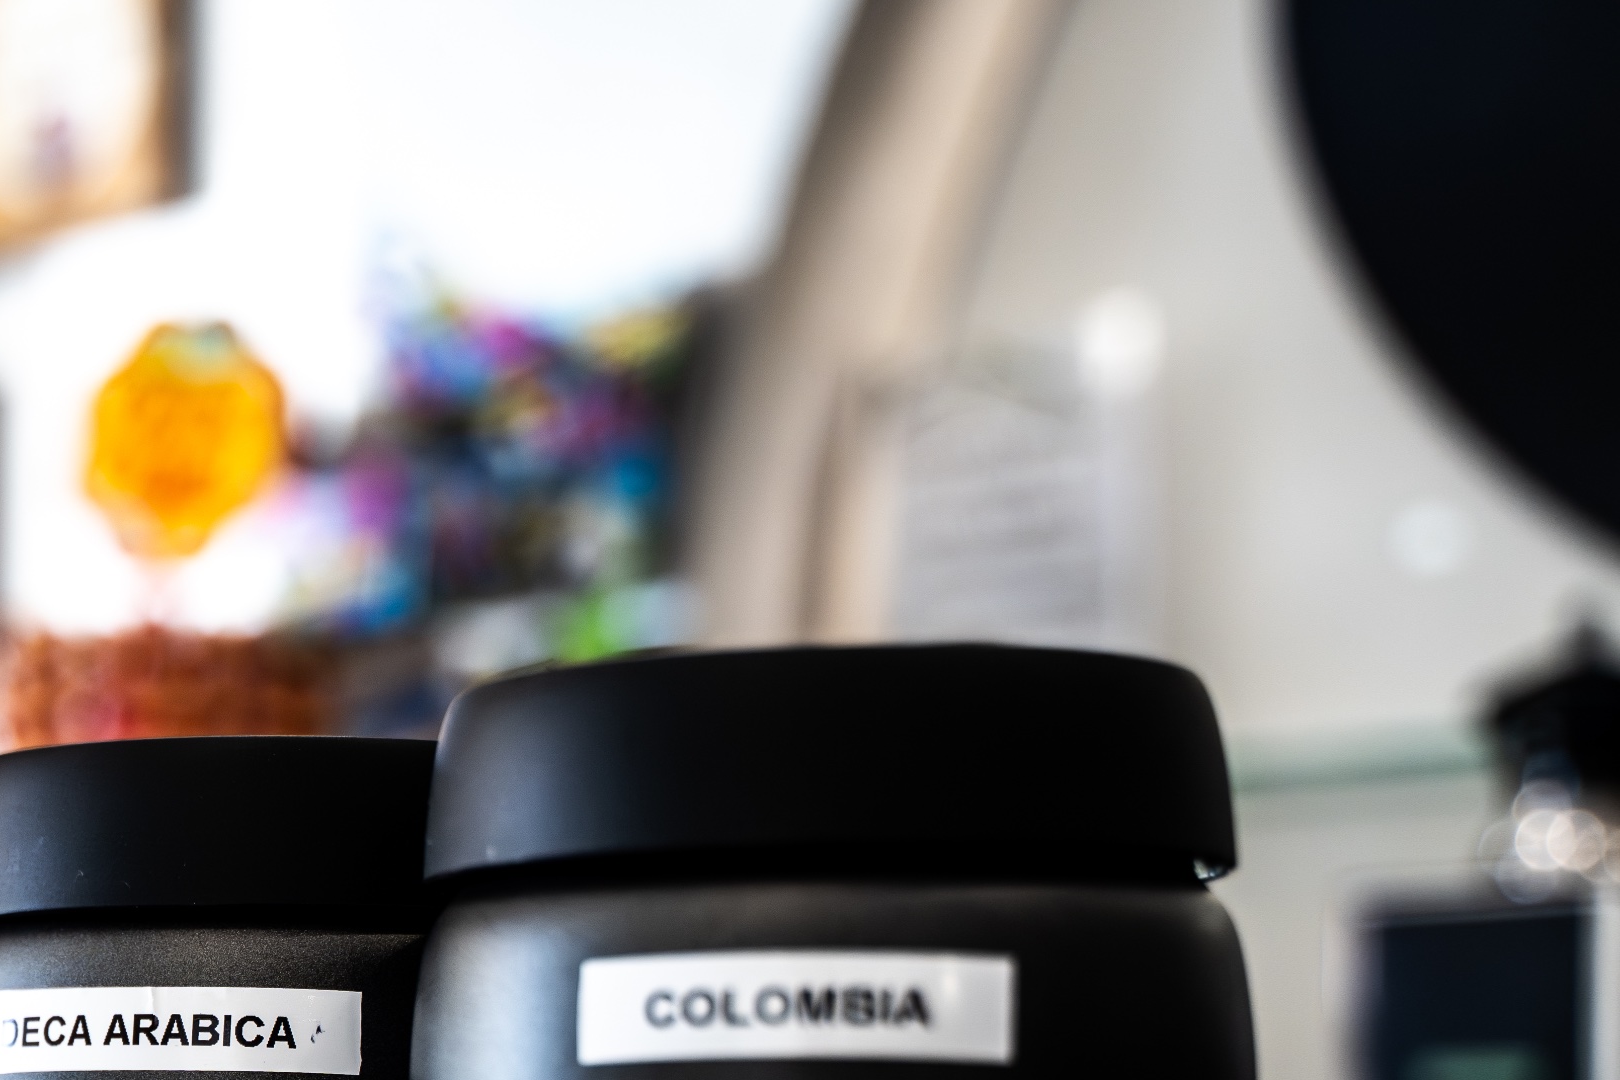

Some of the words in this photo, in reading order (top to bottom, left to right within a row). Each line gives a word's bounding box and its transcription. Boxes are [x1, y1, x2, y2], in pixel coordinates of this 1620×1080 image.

[642, 985, 933, 1030] COLOMBIA
[3, 1014, 93, 1048] DECA
[103, 1013, 298, 1050] ARABICA
